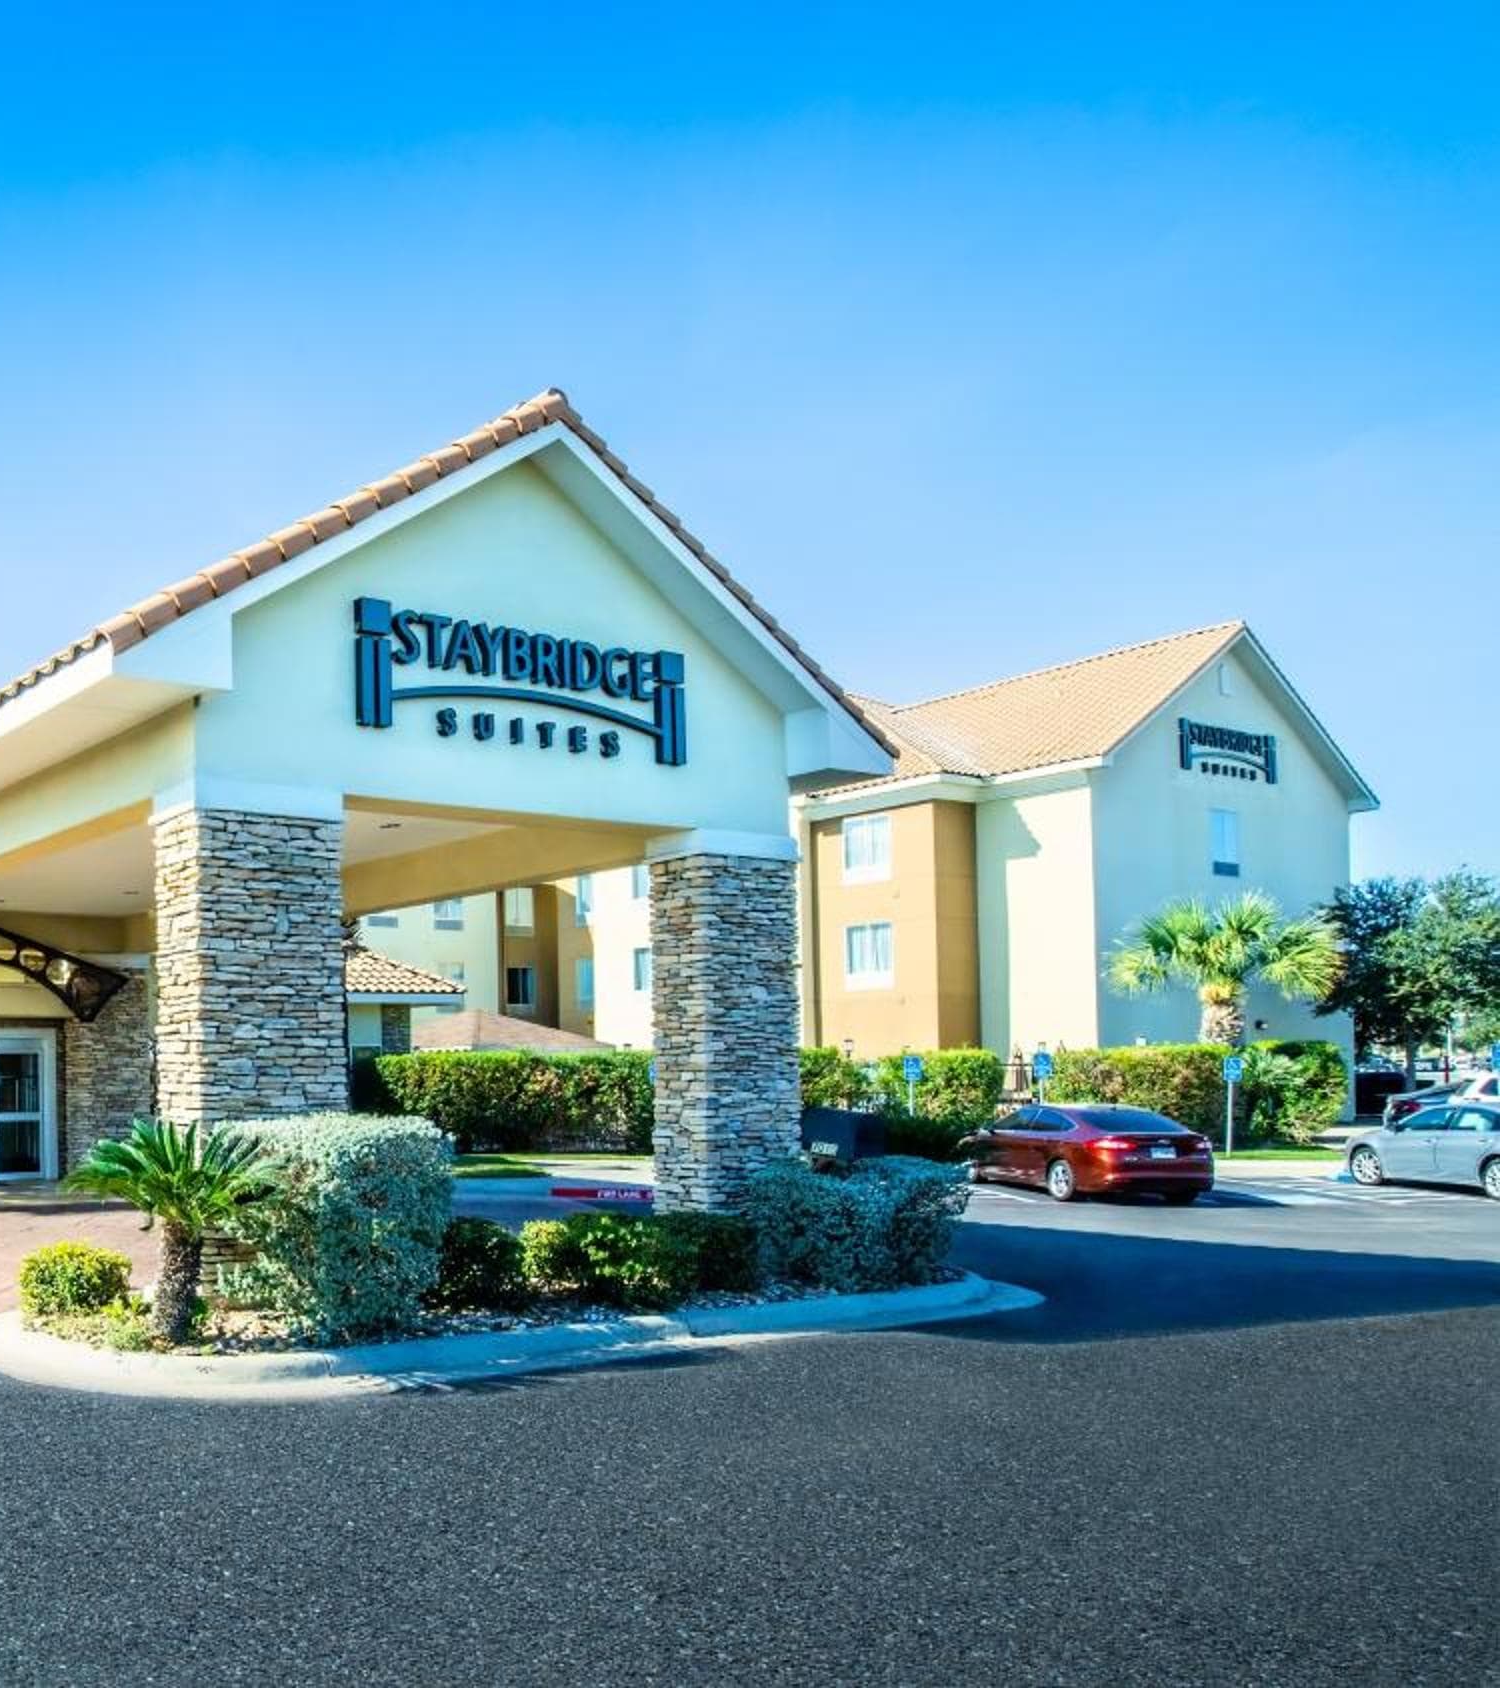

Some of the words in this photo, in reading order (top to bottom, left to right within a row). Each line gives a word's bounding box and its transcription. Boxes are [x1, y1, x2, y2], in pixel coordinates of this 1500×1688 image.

[390, 609, 656, 700] STAYBRIDGE
[435, 708, 621, 758] SUITES
[1201, 761, 1257, 781] SUITES
